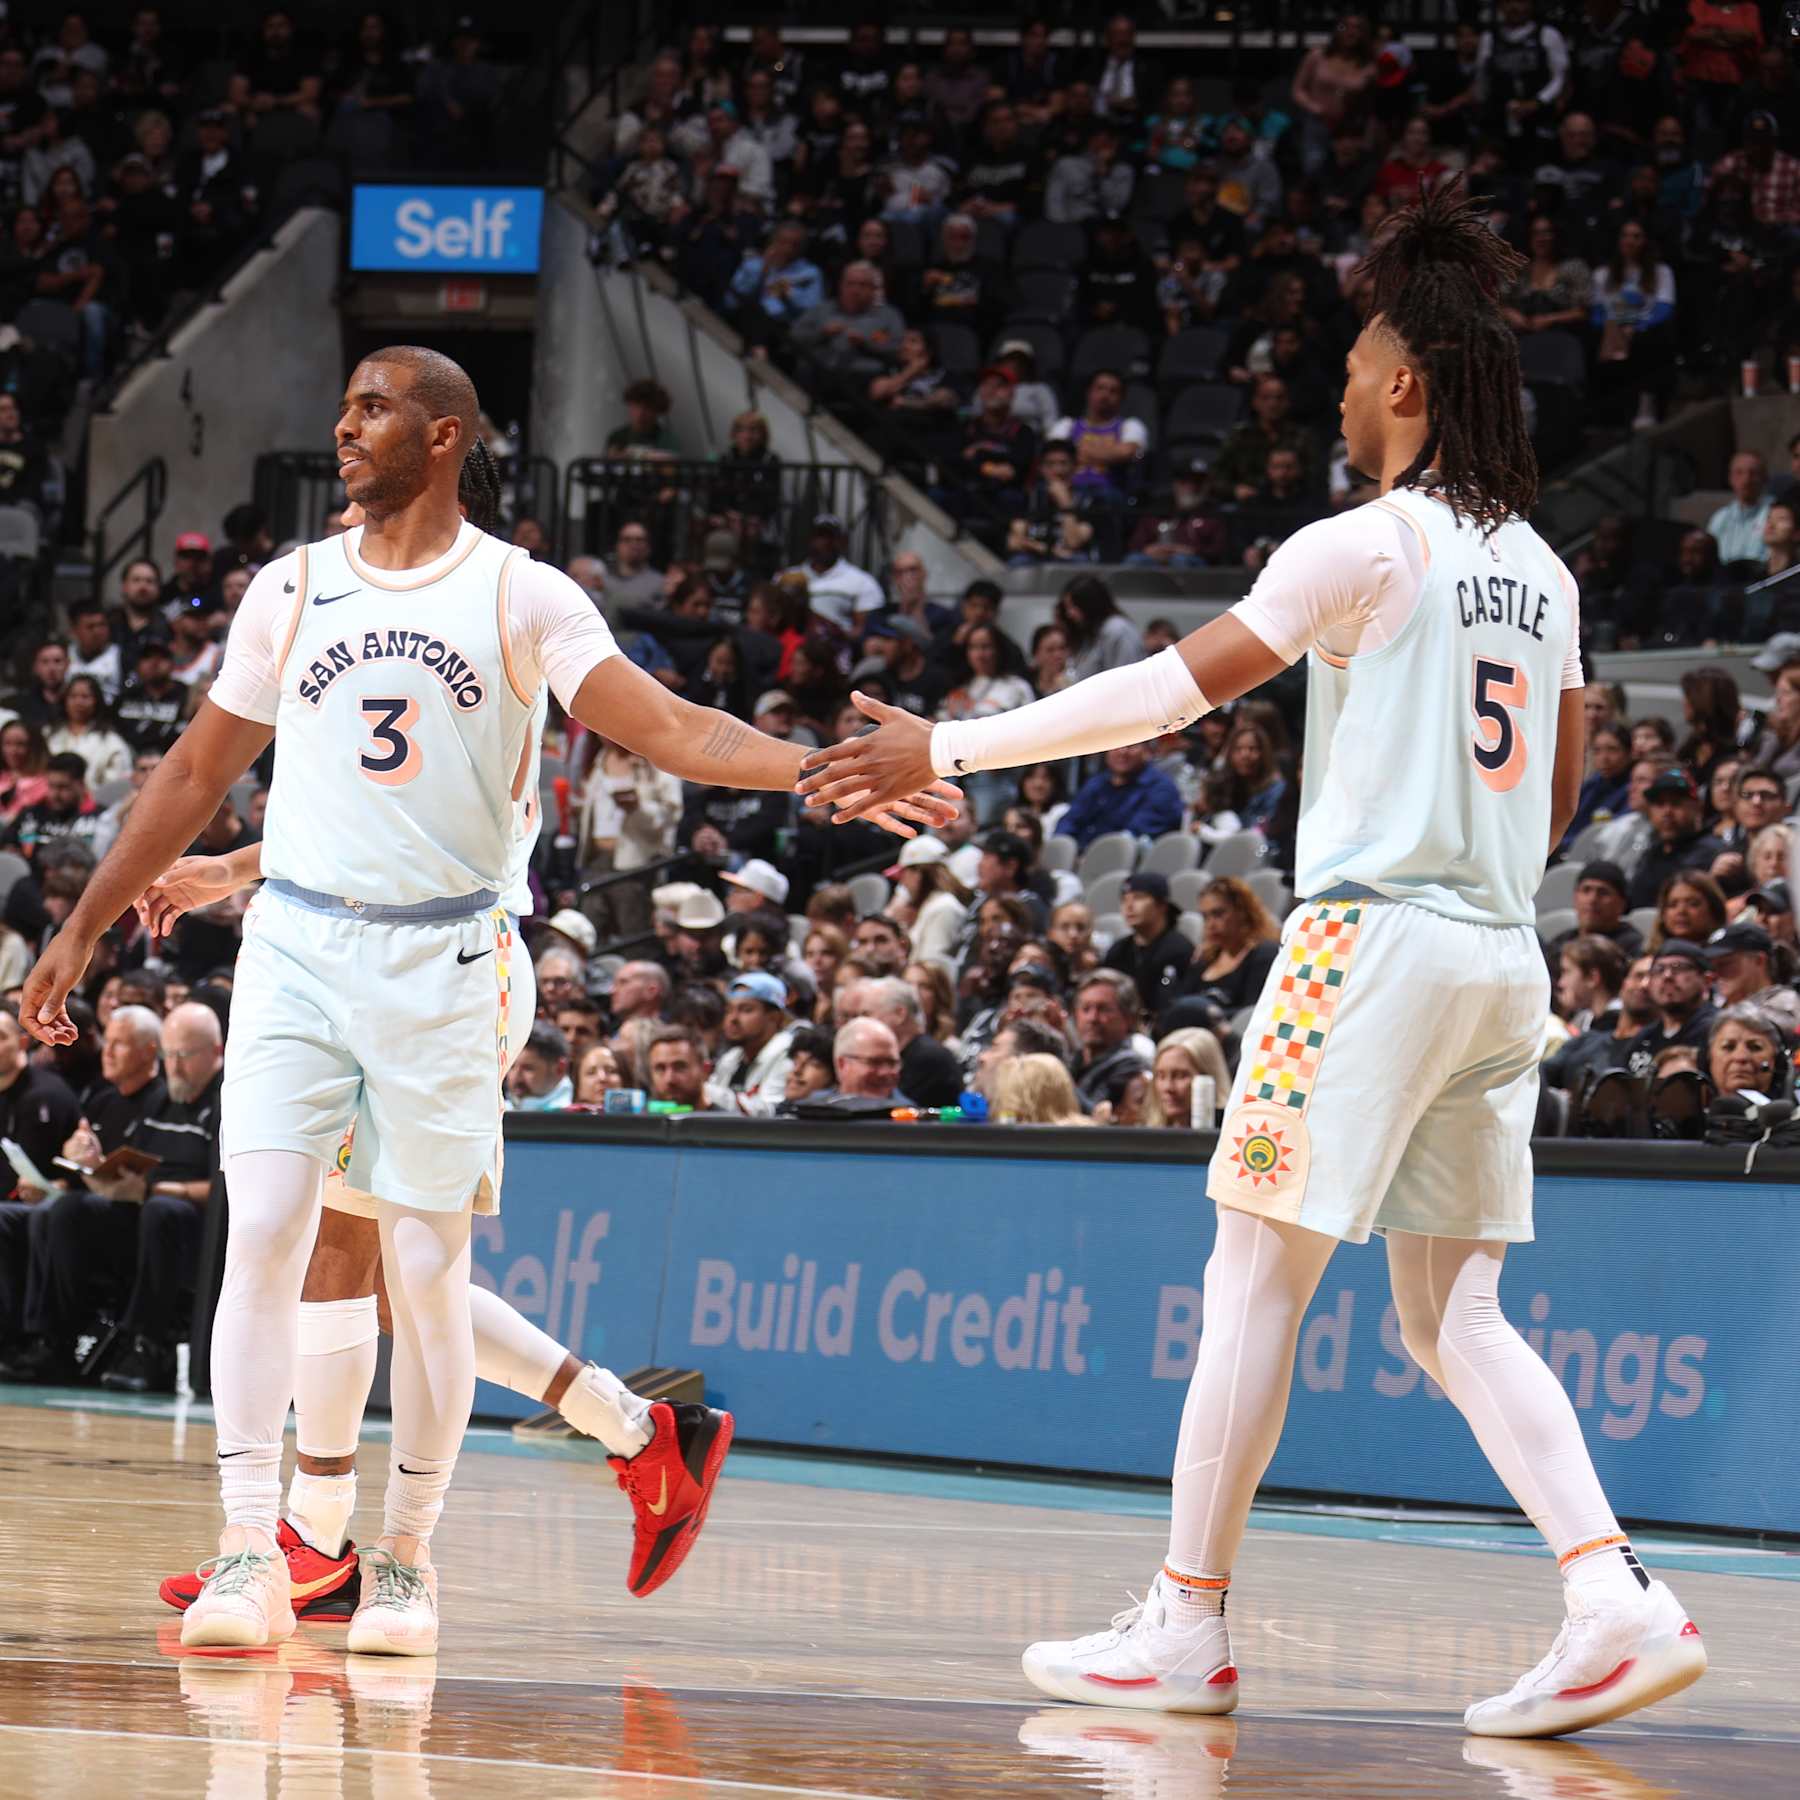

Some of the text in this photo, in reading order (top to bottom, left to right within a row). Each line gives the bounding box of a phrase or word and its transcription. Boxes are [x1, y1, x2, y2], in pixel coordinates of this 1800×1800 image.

[1456, 575, 1550, 643] CASTLE
[299, 630, 483, 709] SAN ANTONIO
[359, 696, 419, 782] 3
[1472, 657, 1523, 785] 5
[690, 1253, 862, 1358] Build
